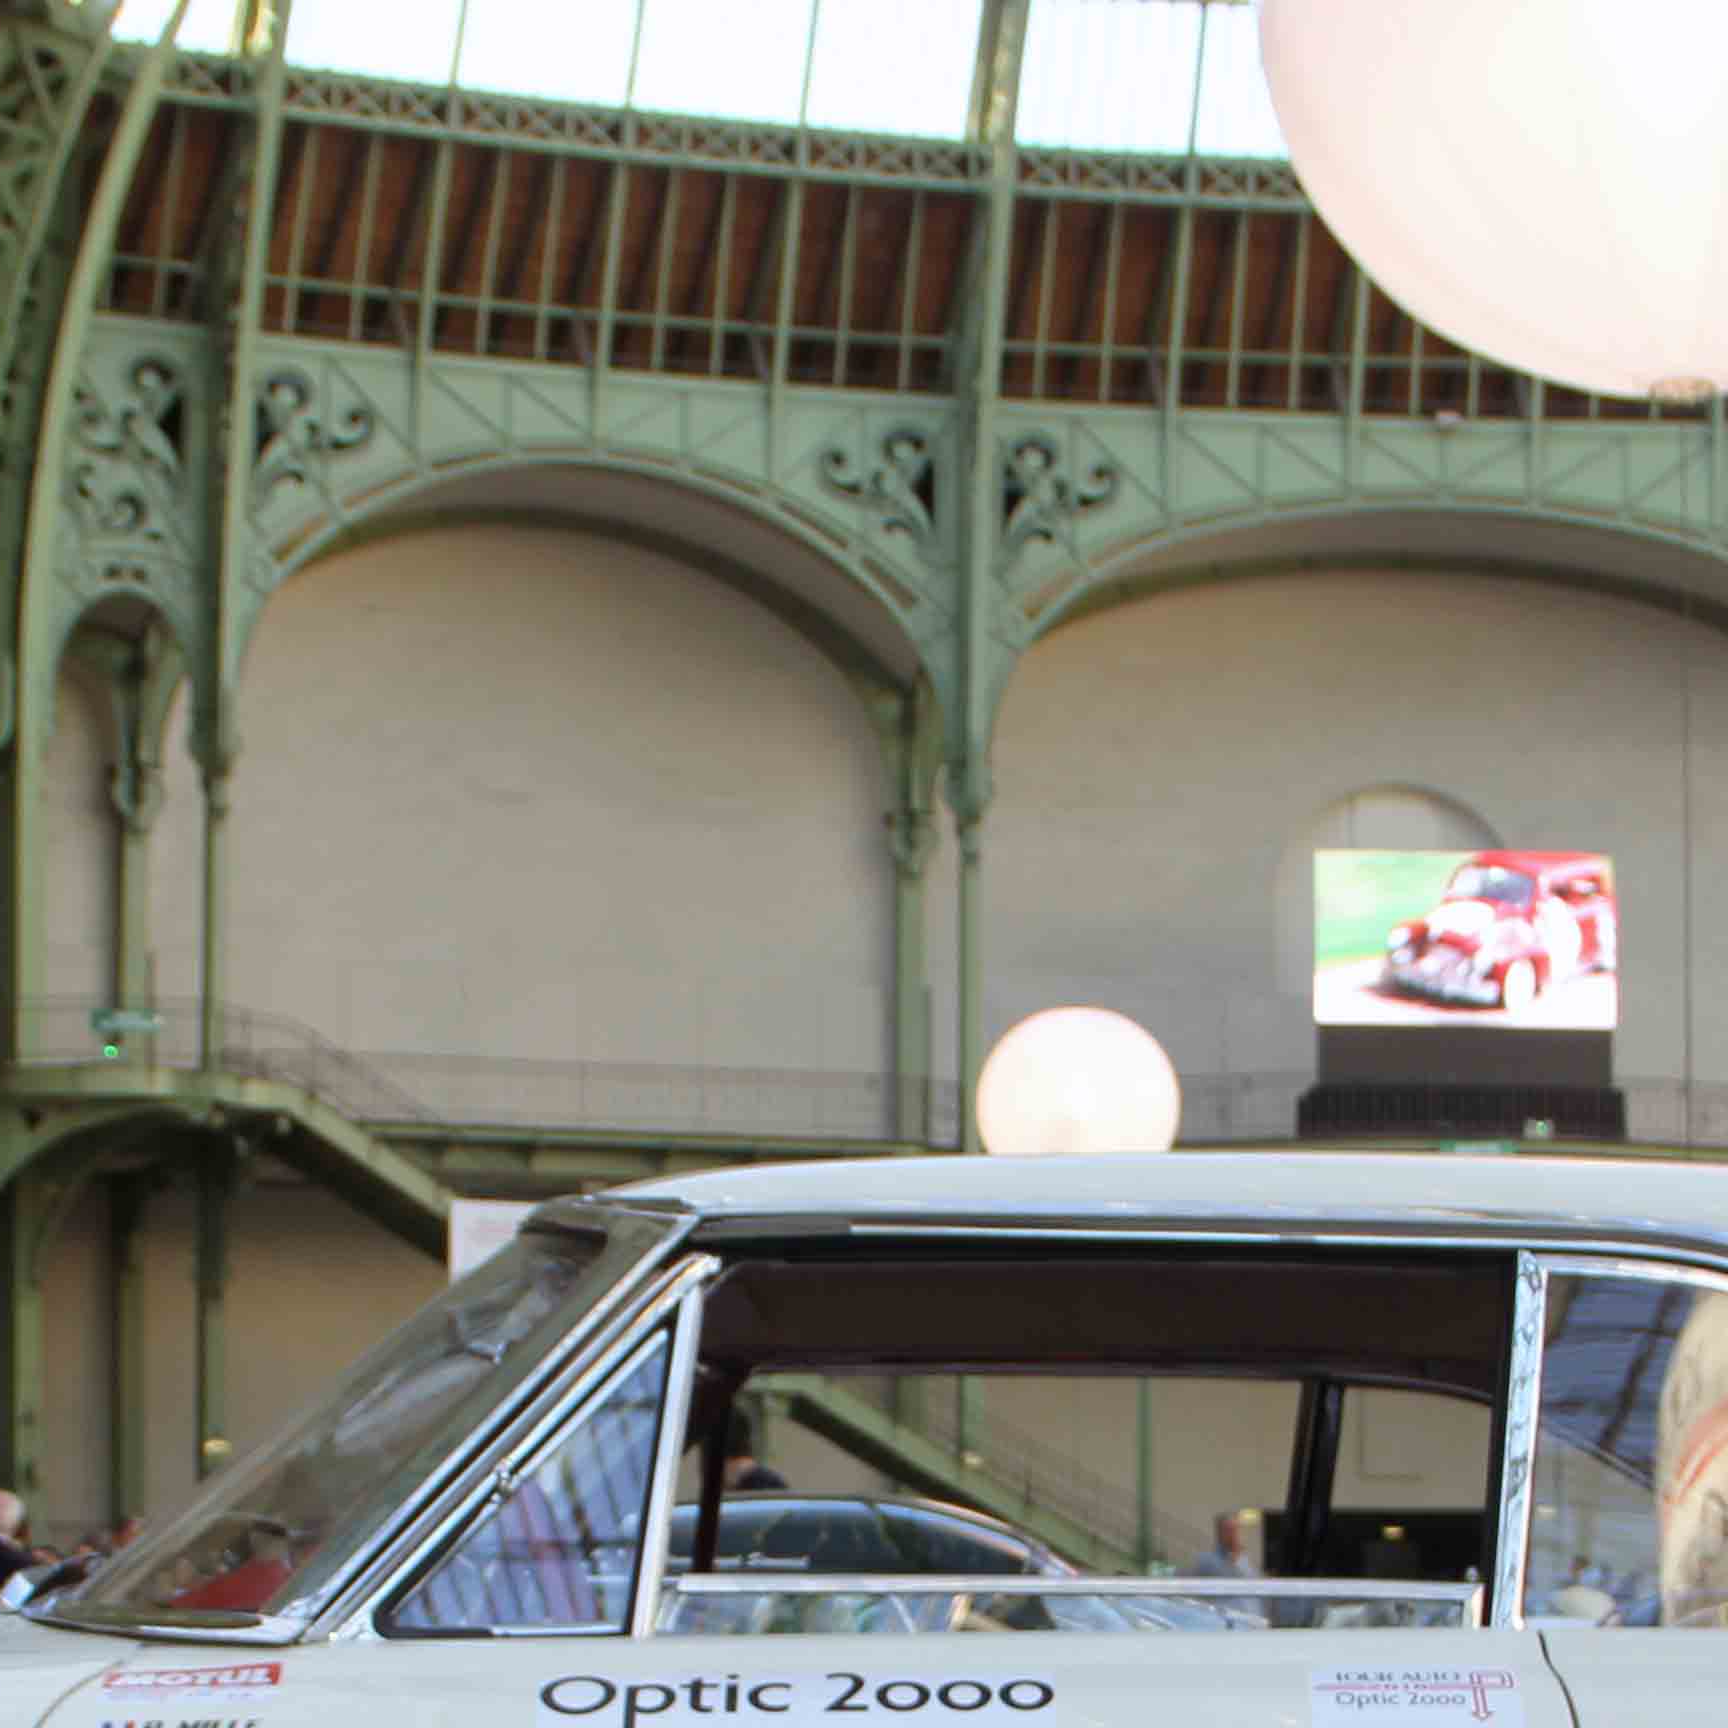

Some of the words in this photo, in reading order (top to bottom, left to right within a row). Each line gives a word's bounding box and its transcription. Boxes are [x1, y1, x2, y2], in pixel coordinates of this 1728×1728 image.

[824, 1672, 1055, 1713] 2000
[1334, 1691, 1400, 1710] Optic
[1407, 1690, 1467, 1706] 2000
